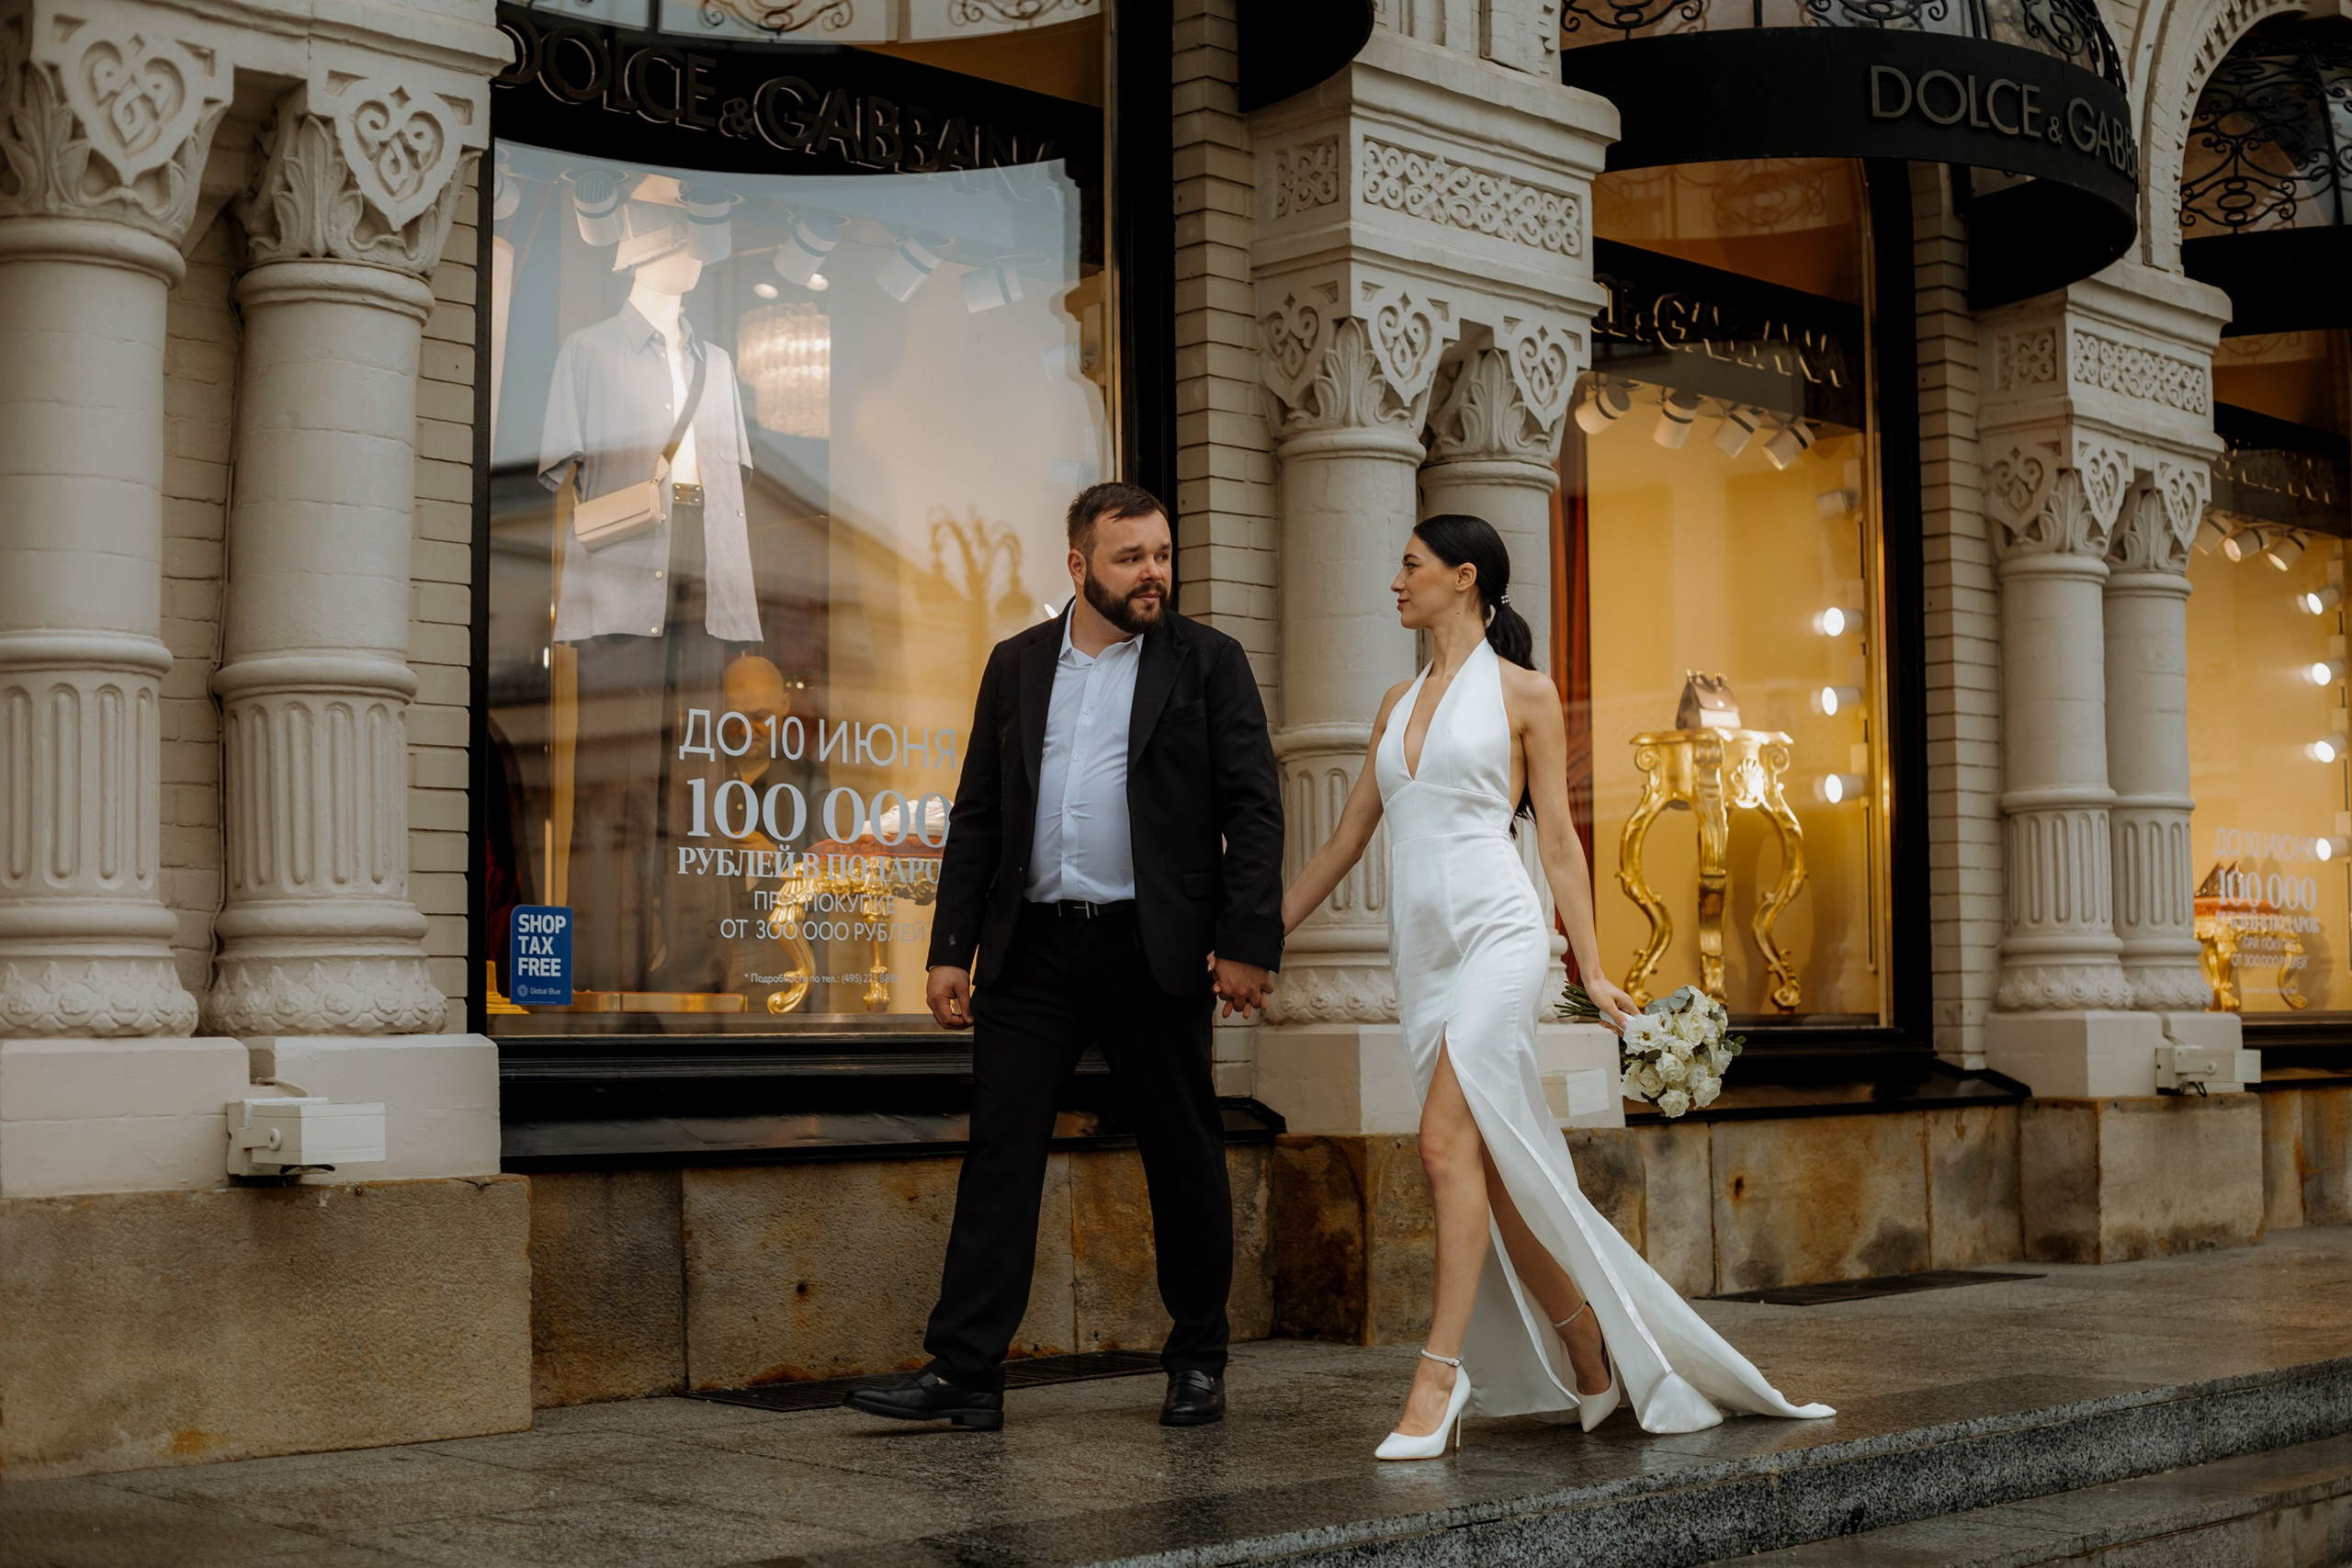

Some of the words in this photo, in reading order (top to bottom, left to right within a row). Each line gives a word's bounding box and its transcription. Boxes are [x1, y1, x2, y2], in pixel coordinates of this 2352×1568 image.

[496, 10, 717, 131] DOLCE
[718, 95, 757, 140] &
[1870, 64, 2042, 138] DOLCE
[2048, 116, 2063, 145] &
[2067, 97, 2138, 181] GABB
[679, 708, 753, 762] ДО
[764, 715, 805, 761] 10
[819, 719, 956, 770] ИЮНЯ
[686, 777, 807, 841] 100
[823, 787, 952, 848] 000
[2215, 828, 2242, 859] ДО
[2245, 830, 2260, 858] 10
[677, 844, 795, 878] РУБЛЕЙ
[801, 852, 820, 879] В
[753, 891, 794, 911] ПРИ
[805, 892, 896, 914] ПОКУПКЕ
[2218, 869, 2262, 908] 100
[2267, 874, 2316, 911] 000
[518, 914, 566, 934] SHOP
[720, 919, 749, 940] ОТ
[756, 919, 798, 941] 300
[802, 920, 850, 942] 000
[518, 936, 554, 955] TAX
[518, 957, 561, 976] FREE
[842, 974, 862, 985] (495)
[879, 974, 900, 984] 888
